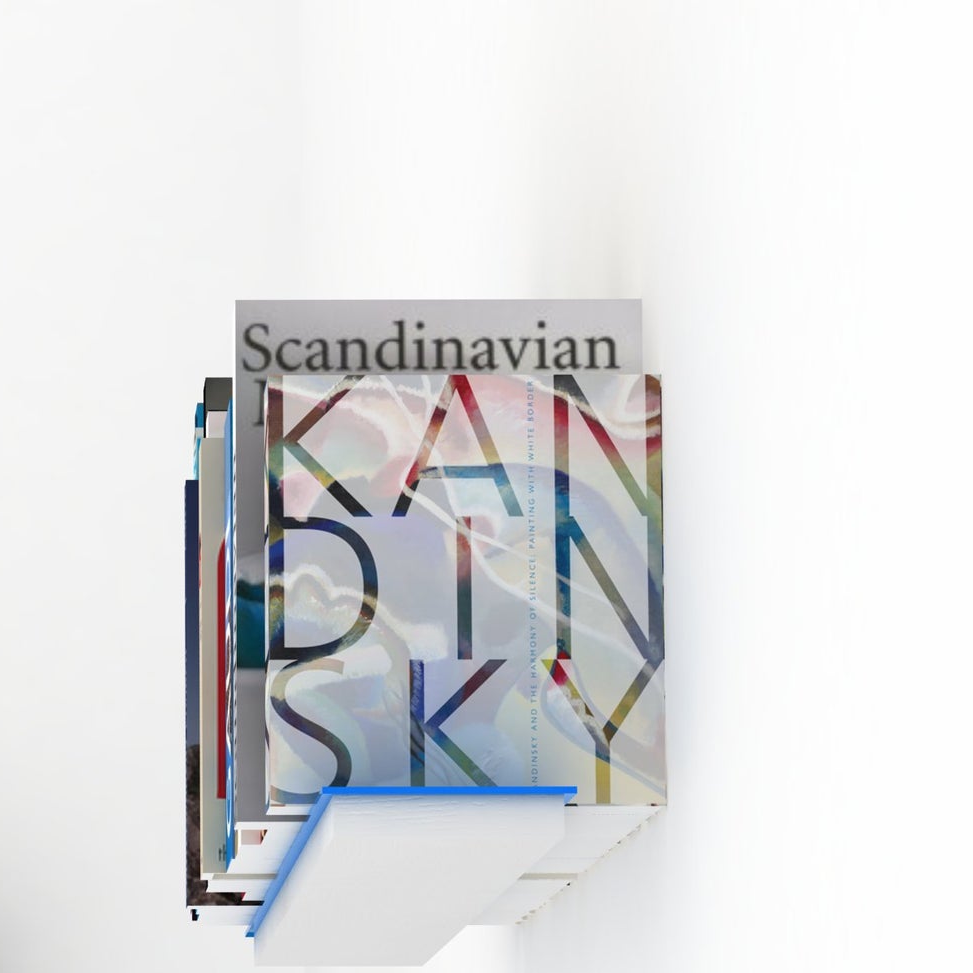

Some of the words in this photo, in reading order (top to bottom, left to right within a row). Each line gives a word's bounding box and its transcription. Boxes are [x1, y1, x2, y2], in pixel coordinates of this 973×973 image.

[242, 319, 622, 372] Scandinavian
[268, 374, 662, 517] KAN
[527, 429, 535, 461] WHITE
[528, 498, 536, 549] PAINTING
[267, 516, 665, 660] DIN
[529, 607, 537, 620] OF
[269, 658, 665, 804] SKY
[530, 737, 538, 787] NDINSKY
